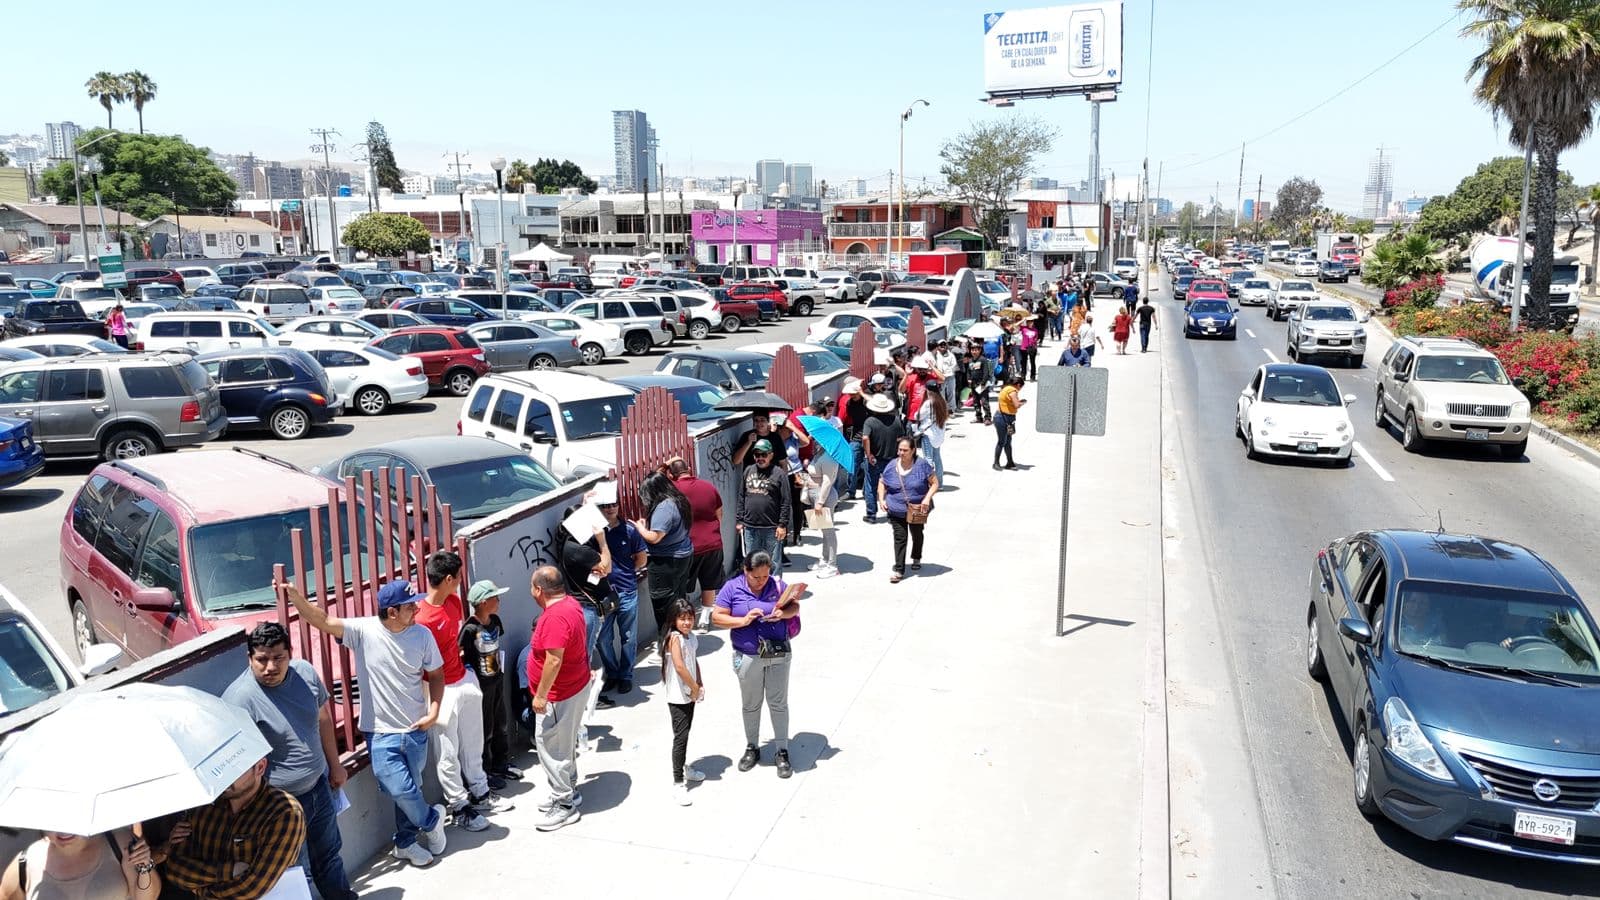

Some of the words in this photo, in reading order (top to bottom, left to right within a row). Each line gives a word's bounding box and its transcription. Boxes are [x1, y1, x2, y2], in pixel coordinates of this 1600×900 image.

[997, 31, 1048, 46] TECATITA
[1082, 24, 1091, 64] TECATITA
[1518, 819, 1572, 838] AYR-592-A
